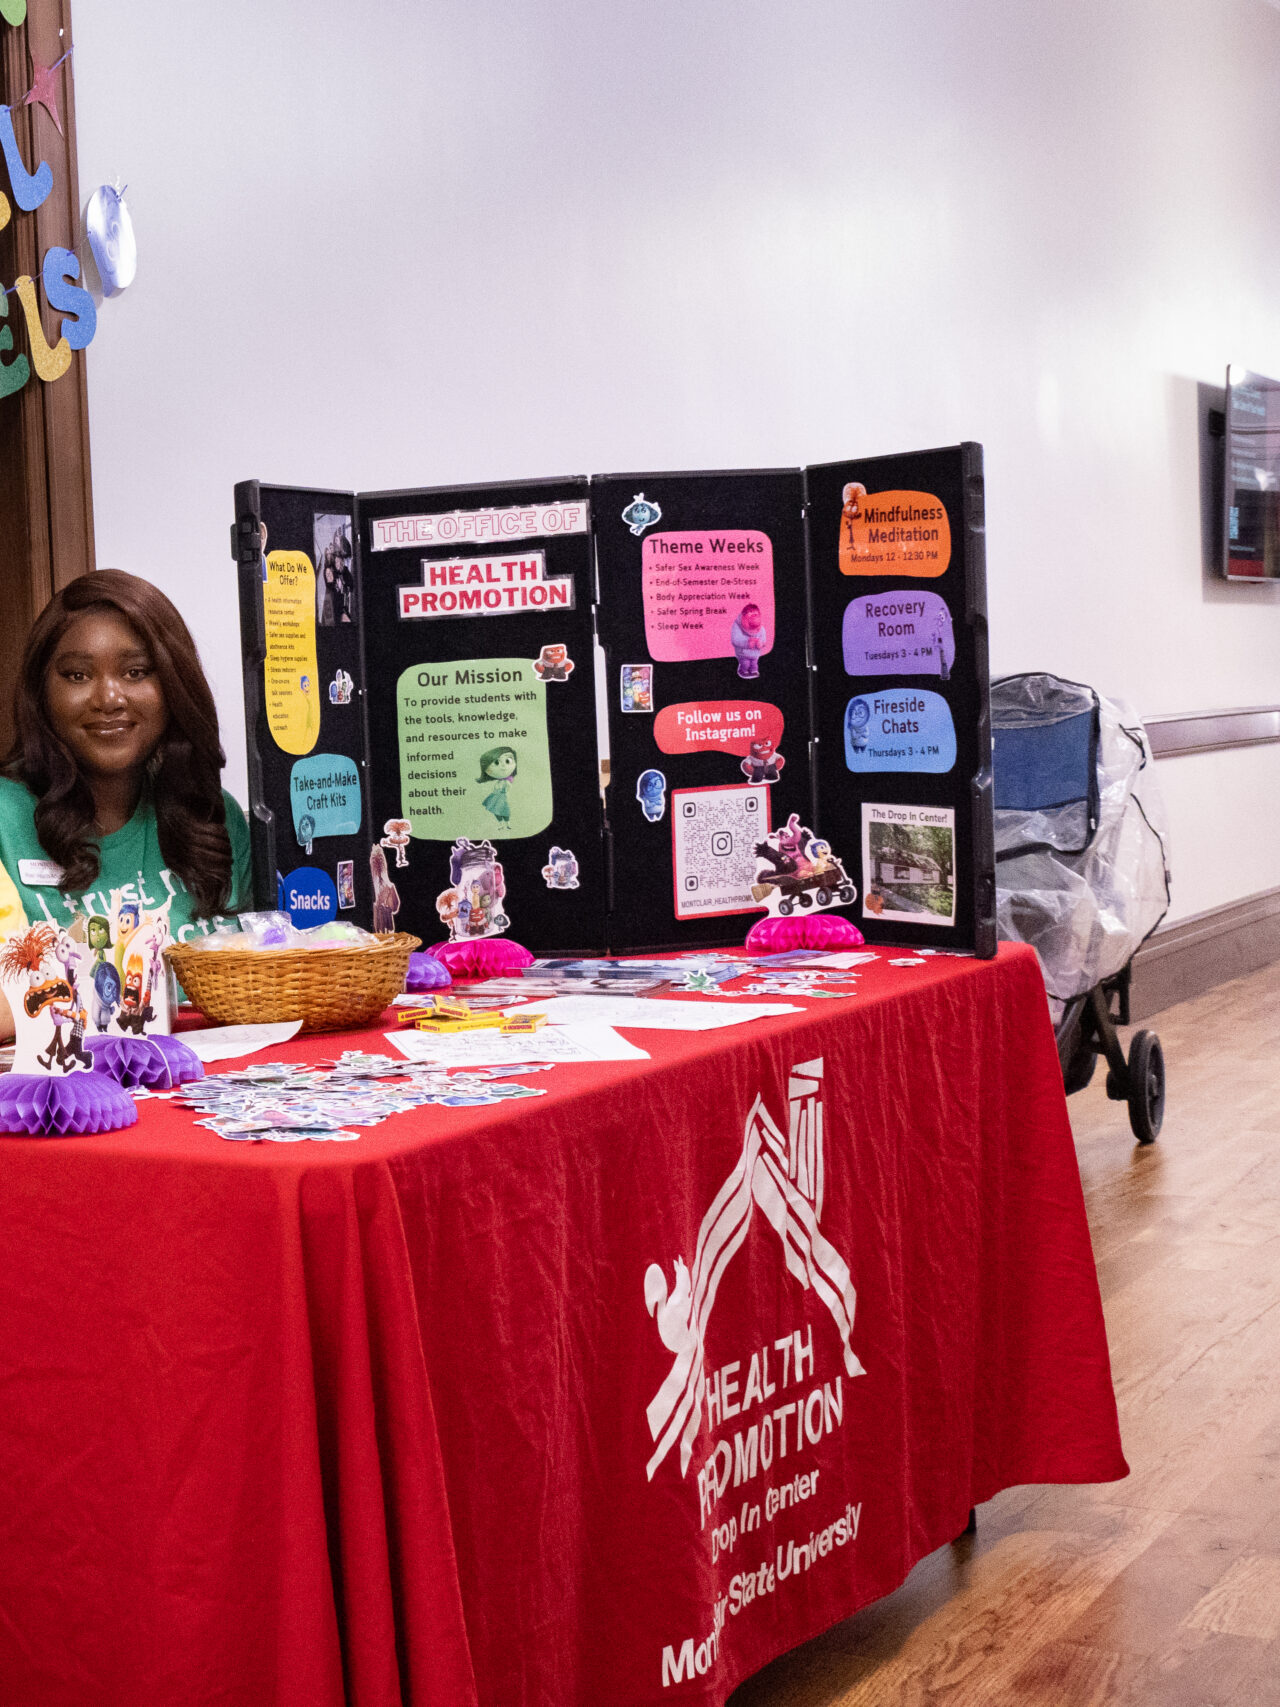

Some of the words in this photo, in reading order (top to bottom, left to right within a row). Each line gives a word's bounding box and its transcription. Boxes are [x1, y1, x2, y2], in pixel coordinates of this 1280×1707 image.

[864, 504, 943, 524] Mindfulness
[378, 519, 432, 543] THE
[438, 511, 537, 538] OFFICE
[542, 508, 580, 531] OF
[868, 526, 939, 544] Meditation
[649, 539, 703, 554] Theme
[709, 538, 764, 553] Weeks
[850, 552, 884, 563] Mondays
[885, 552, 895, 561] 12
[926, 550, 938, 560] PM
[269, 561, 285, 572] What
[287, 562, 295, 572] Do
[297, 563, 307, 573] We
[429, 560, 537, 586] HEALTH
[655, 564, 676, 572] Safer
[695, 563, 735, 571] Awareness
[737, 563, 760, 571] Week
[279, 575, 298, 586] Offer?
[655, 578, 718, 586] End-of-Semester
[721, 577, 757, 586] De-Stress
[403, 584, 567, 613] PROMOTION
[656, 593, 675, 602] Body
[678, 592, 726, 602] Appreciation
[728, 592, 750, 600] Week
[657, 607, 677, 615] Safer
[680, 607, 703, 616] Spring
[705, 607, 727, 615] Break
[865, 601, 925, 618] Recovery
[657, 622, 679, 630] Sleep
[682, 622, 703, 630] Week
[878, 622, 915, 637] Room
[865, 649, 899, 661] Tuesdays
[901, 649, 907, 658] 3
[913, 648, 919, 657] 4
[921, 647, 933, 656] PM
[417, 672, 448, 687] Our
[455, 668, 522, 685] Mission
[404, 697, 417, 707] To
[421, 696, 461, 708] provide
[464, 693, 510, 704] students
[514, 691, 537, 701] with
[874, 697, 925, 715] Fireside
[404, 716, 422, 725] the
[425, 714, 454, 724] tools,
[458, 711, 518, 722] knowledge,
[677, 710, 721, 725] Follow
[726, 711, 741, 721] us
[745, 709, 762, 720] on
[685, 723, 756, 742] Instagram!
[881, 718, 919, 735] Chats
[405, 733, 425, 743] and
[428, 731, 480, 742] resources
[483, 730, 495, 739] to
[498, 729, 527, 738] make
[407, 751, 454, 762] informed
[868, 747, 906, 758] Thursdays
[908, 747, 913, 756] 3
[920, 747, 925, 756] 4
[928, 746, 939, 755] PM
[293, 771, 357, 792] Take-and-Make
[408, 770, 457, 780] decisions
[408, 788, 438, 798] about
[442, 787, 467, 796] their
[306, 795, 328, 811] Craft
[330, 793, 347, 808] Kits
[872, 809, 886, 819] The
[888, 810, 907, 822] Drop
[909, 811, 916, 820] In
[919, 812, 948, 823] Center!
[290, 889, 330, 910] Snacks
[705, 1324, 814, 1433] HEALTH
[740, 1502, 760, 1534] In
[729, 1562, 775, 1616] State
[777, 1502, 862, 1581] University
